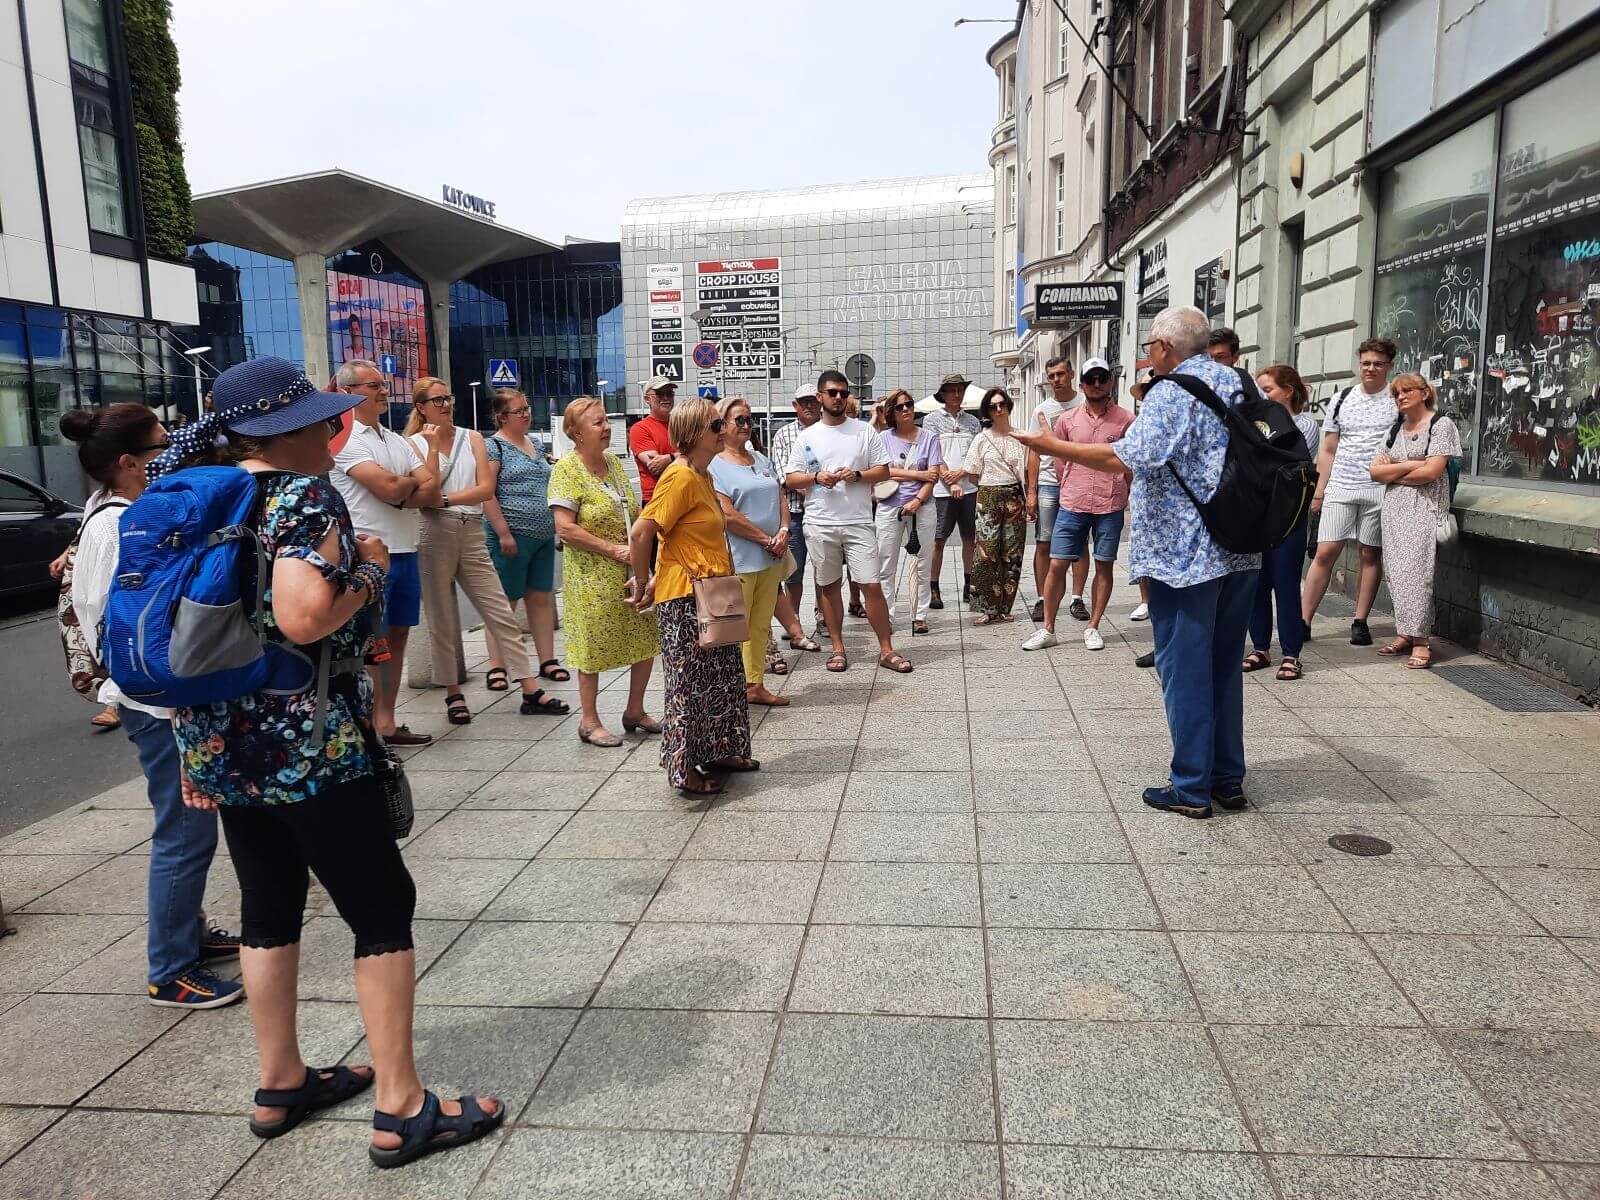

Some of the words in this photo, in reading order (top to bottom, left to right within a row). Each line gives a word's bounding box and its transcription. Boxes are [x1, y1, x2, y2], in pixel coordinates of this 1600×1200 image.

[443, 184, 496, 218] KATOWICE
[700, 275, 736, 286] CROPP
[848, 259, 966, 293] GALERIA
[1040, 285, 1118, 304] COMMANDO
[740, 302, 778, 311] eobuwie.pl
[828, 287, 989, 323] KATOWICKA
[702, 316, 737, 326] OYSHO
[652, 333, 681, 341] DOUGLAS
[658, 346, 675, 354] CCC
[656, 363, 679, 377] C&A
